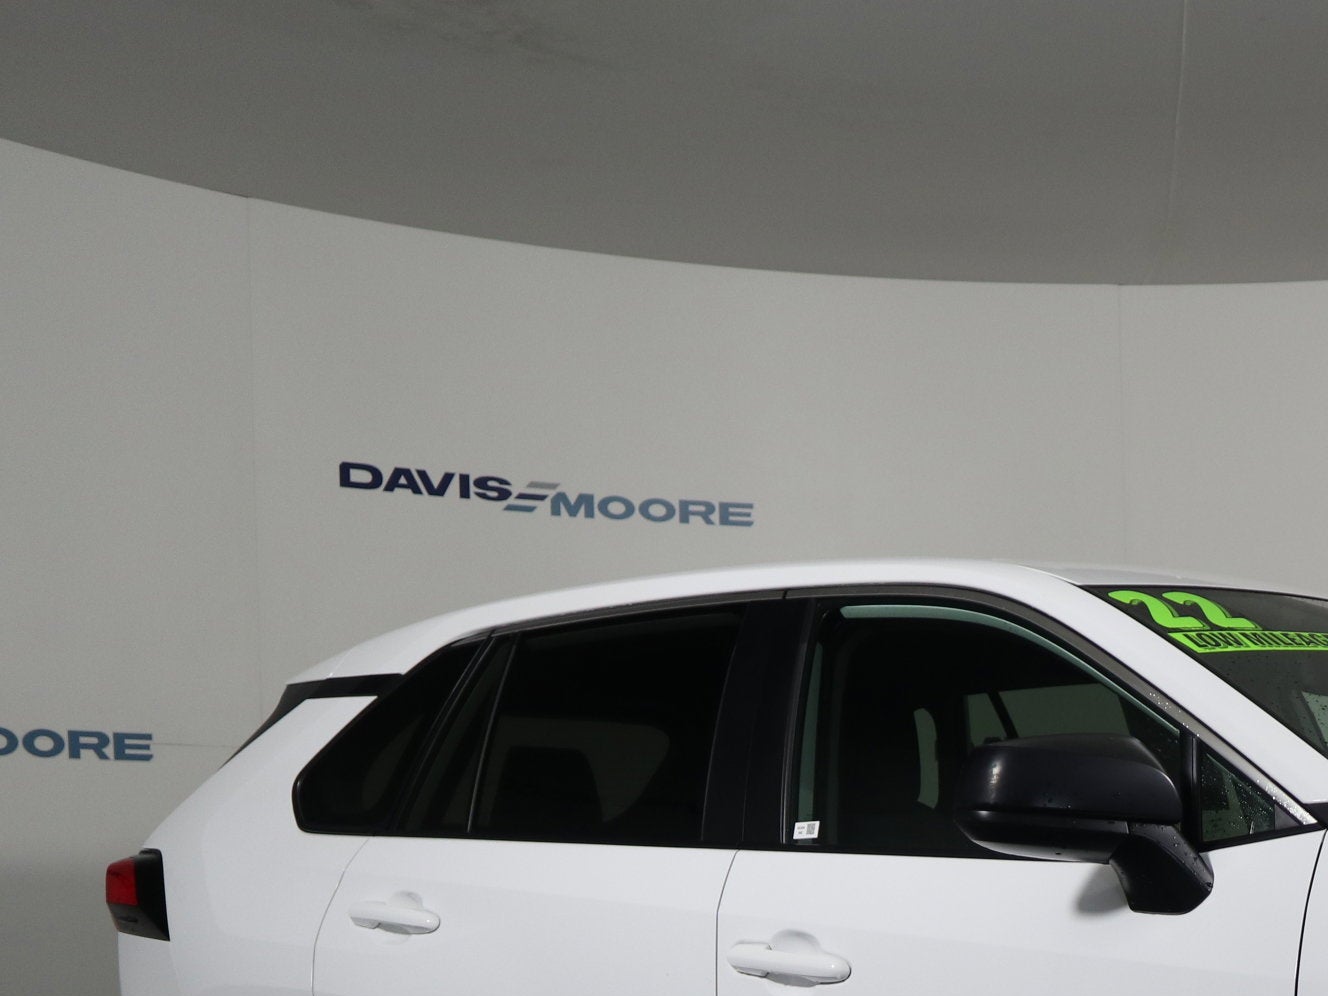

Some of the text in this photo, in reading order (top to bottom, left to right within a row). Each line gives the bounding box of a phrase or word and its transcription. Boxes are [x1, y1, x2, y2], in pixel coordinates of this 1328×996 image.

[339, 461, 755, 527] DAVIS MOORE
[1107, 590, 1262, 630] 22
[1182, 632, 1244, 649] LOW
